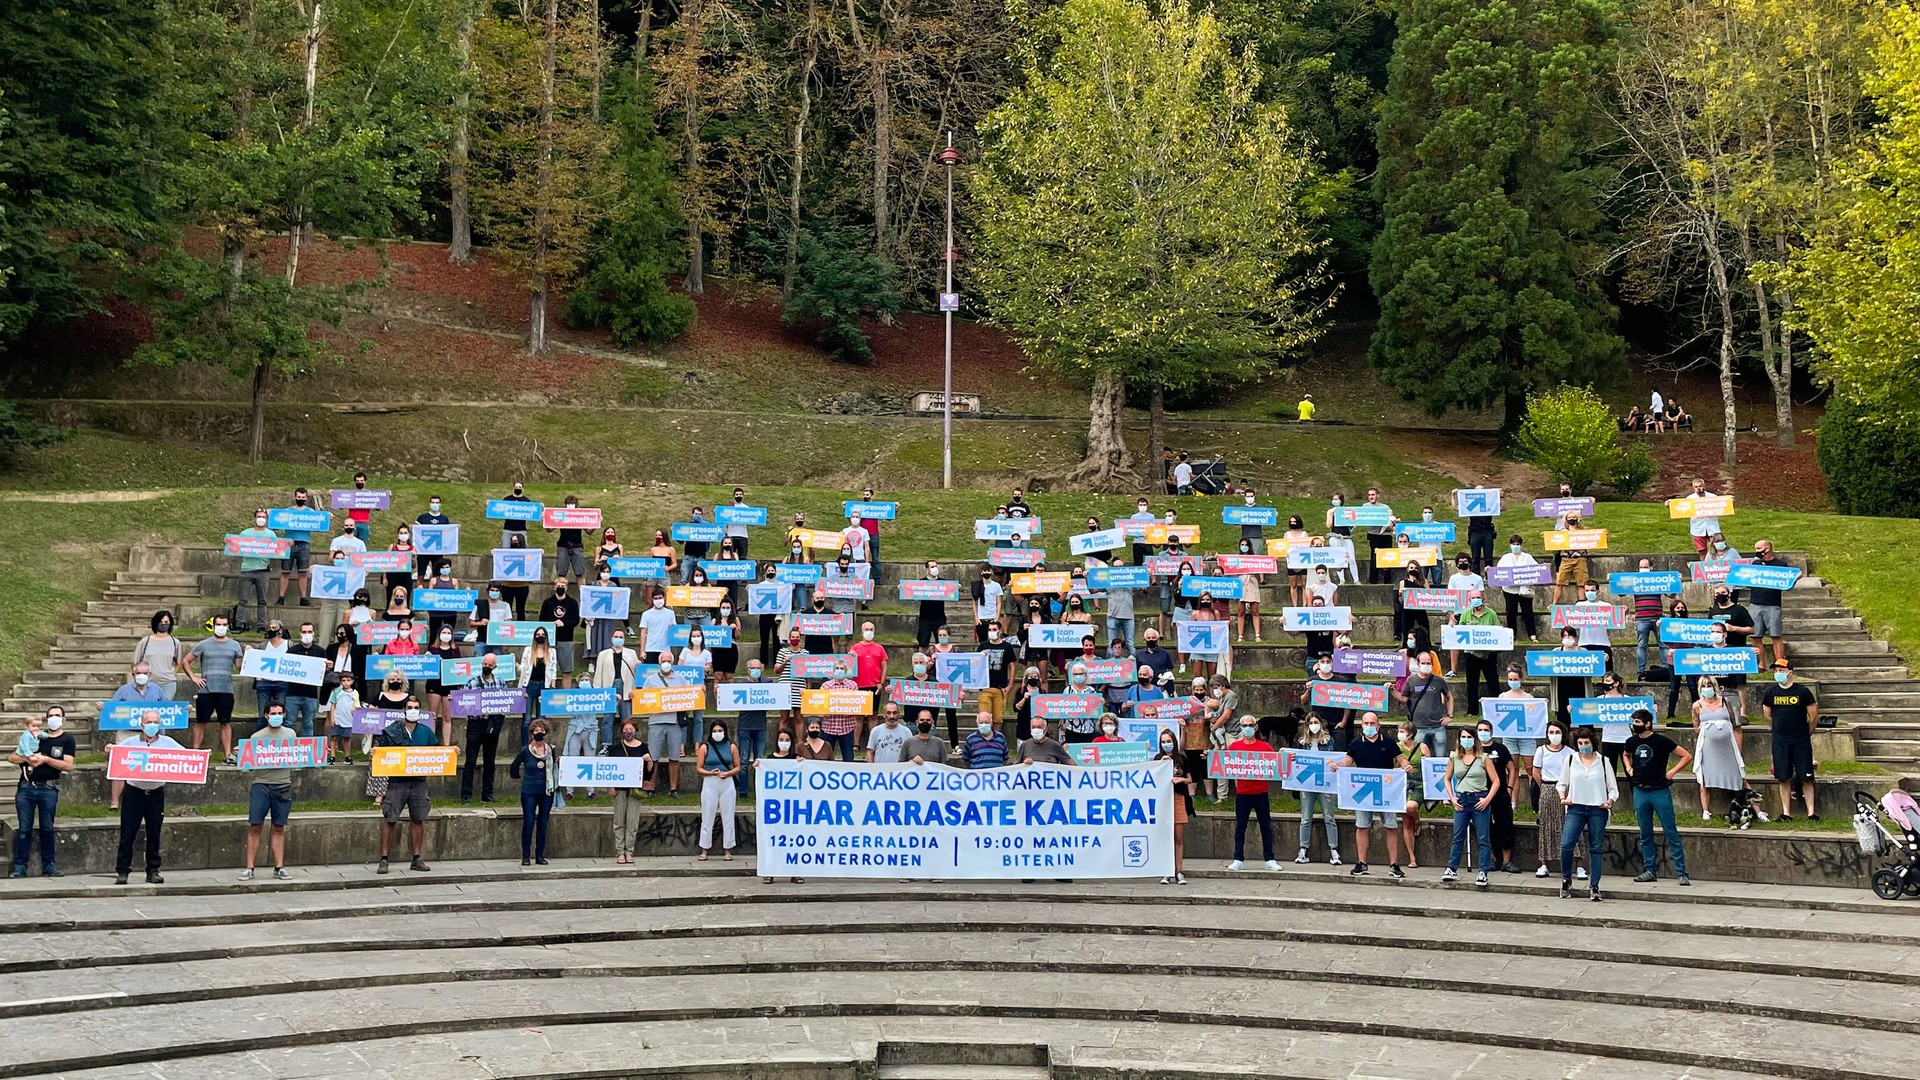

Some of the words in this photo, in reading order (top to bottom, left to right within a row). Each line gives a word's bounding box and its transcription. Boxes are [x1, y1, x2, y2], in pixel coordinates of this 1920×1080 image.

[506, 505, 537, 513] presoak
[1694, 501, 1728, 510] presoak
[289, 512, 325, 522] presoak
[564, 514, 598, 523] amaitu!
[289, 521, 320, 529] etxera!
[689, 525, 722, 534] presoak
[1416, 526, 1450, 534] presoak
[1568, 535, 1601, 543] presoak
[1093, 540, 1113, 548] bidea
[627, 561, 661, 570] presoak
[719, 563, 751, 572] presoak
[1239, 561, 1274, 569] amaitu!
[718, 570, 747, 578] etxera!
[785, 567, 820, 575] presoak
[1753, 570, 1795, 579] presoak
[783, 574, 813, 582] etxera!
[1633, 575, 1675, 585] presoak
[1751, 577, 1790, 587] etxera!
[1202, 580, 1238, 589] presoak
[1633, 583, 1670, 592] etxera!
[435, 593, 473, 602] presoak
[690, 591, 723, 599] presoak
[1416, 593, 1457, 601] Salbuespen
[1566, 610, 1610, 618] Salbuespen
[1553, 655, 1599, 665] presoak
[1701, 651, 1750, 662] presoak
[279, 658, 300, 668] izan
[1363, 660, 1394, 668] presoak
[1701, 661, 1744, 671] etxera!
[278, 666, 306, 678] bidea
[1363, 667, 1390, 675] etxera!
[1553, 665, 1593, 674] etxera!
[481, 690, 522, 698] emakume
[750, 688, 769, 696] izan
[904, 685, 948, 696] Salbuespen
[1328, 688, 1360, 697] medidas
[481, 697, 514, 706] presoak
[662, 692, 699, 702] presoak
[750, 696, 775, 704] bidea
[830, 696, 867, 705] presoak
[905, 694, 945, 703] neurriekin
[1330, 696, 1370, 705] excepción
[566, 703, 605, 711] etxera!
[662, 700, 695, 710] etxera!
[830, 705, 862, 713] etxera!
[1598, 701, 1648, 712] presoak
[1048, 706, 1086, 714] excepción
[129, 716, 175, 726] etra!
[1599, 712, 1632, 722] etxer
[256, 745, 311, 754] Salbuespen
[147, 753, 204, 761] urrunketarekin
[257, 754, 308, 764] neurriekin
[406, 755, 450, 765] presoak
[1099, 755, 1147, 764] ahalbidetu!
[1223, 756, 1276, 766] Salbuespen
[145, 762, 202, 774] amaitu!
[406, 764, 444, 774] etxera!
[596, 762, 618, 771] izan
[1226, 766, 1274, 775] neurriekin
[595, 771, 625, 781] bidea
[764, 771, 802, 790] BIZI
[809, 771, 920, 790] OSORAKO
[926, 770, 1072, 790] ZIGORRAREN
[1078, 769, 1156, 789] AURKA
[763, 800, 852, 826] BIHAR
[862, 799, 1017, 826] ARRASATE
[1026, 798, 1156, 825] KALERA!
[770, 835, 817, 849] 12:00
[826, 836, 939, 849] AGERRALDIA
[974, 836, 1024, 849] 19:00
[1033, 836, 1102, 849] MANIFA
[786, 853, 922, 867] MONTERRONEN
[1002, 853, 1074, 867] BITERIN
